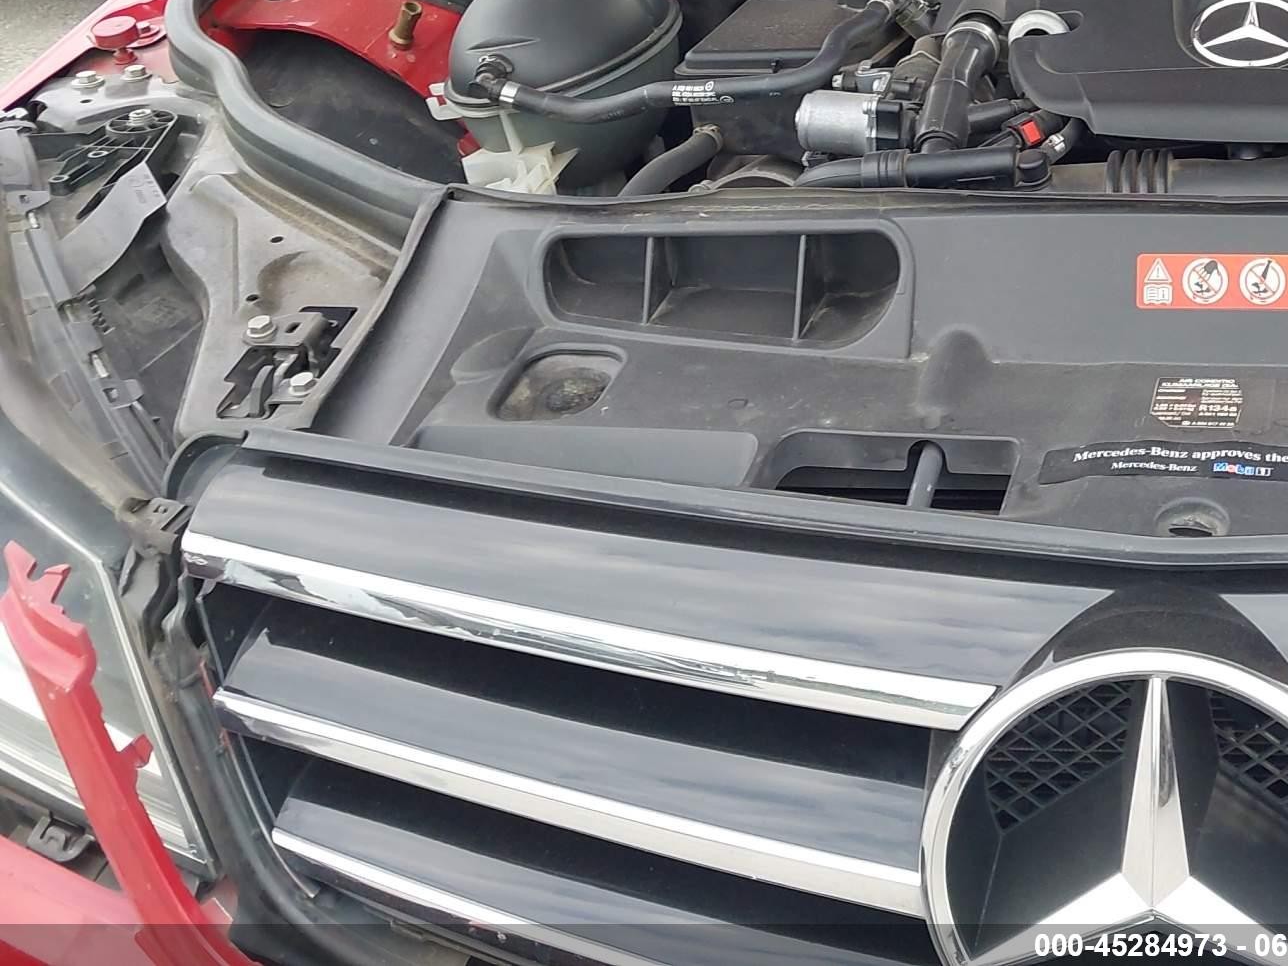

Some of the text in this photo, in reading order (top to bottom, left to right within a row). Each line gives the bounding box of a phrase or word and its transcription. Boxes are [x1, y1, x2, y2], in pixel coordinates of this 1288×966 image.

[1198, 404, 1238, 412] R134a
[1072, 446, 1188, 463] Mercedes-Benz
[1191, 449, 1262, 461] approves
[1110, 461, 1200, 473] Mercedes-Benz
